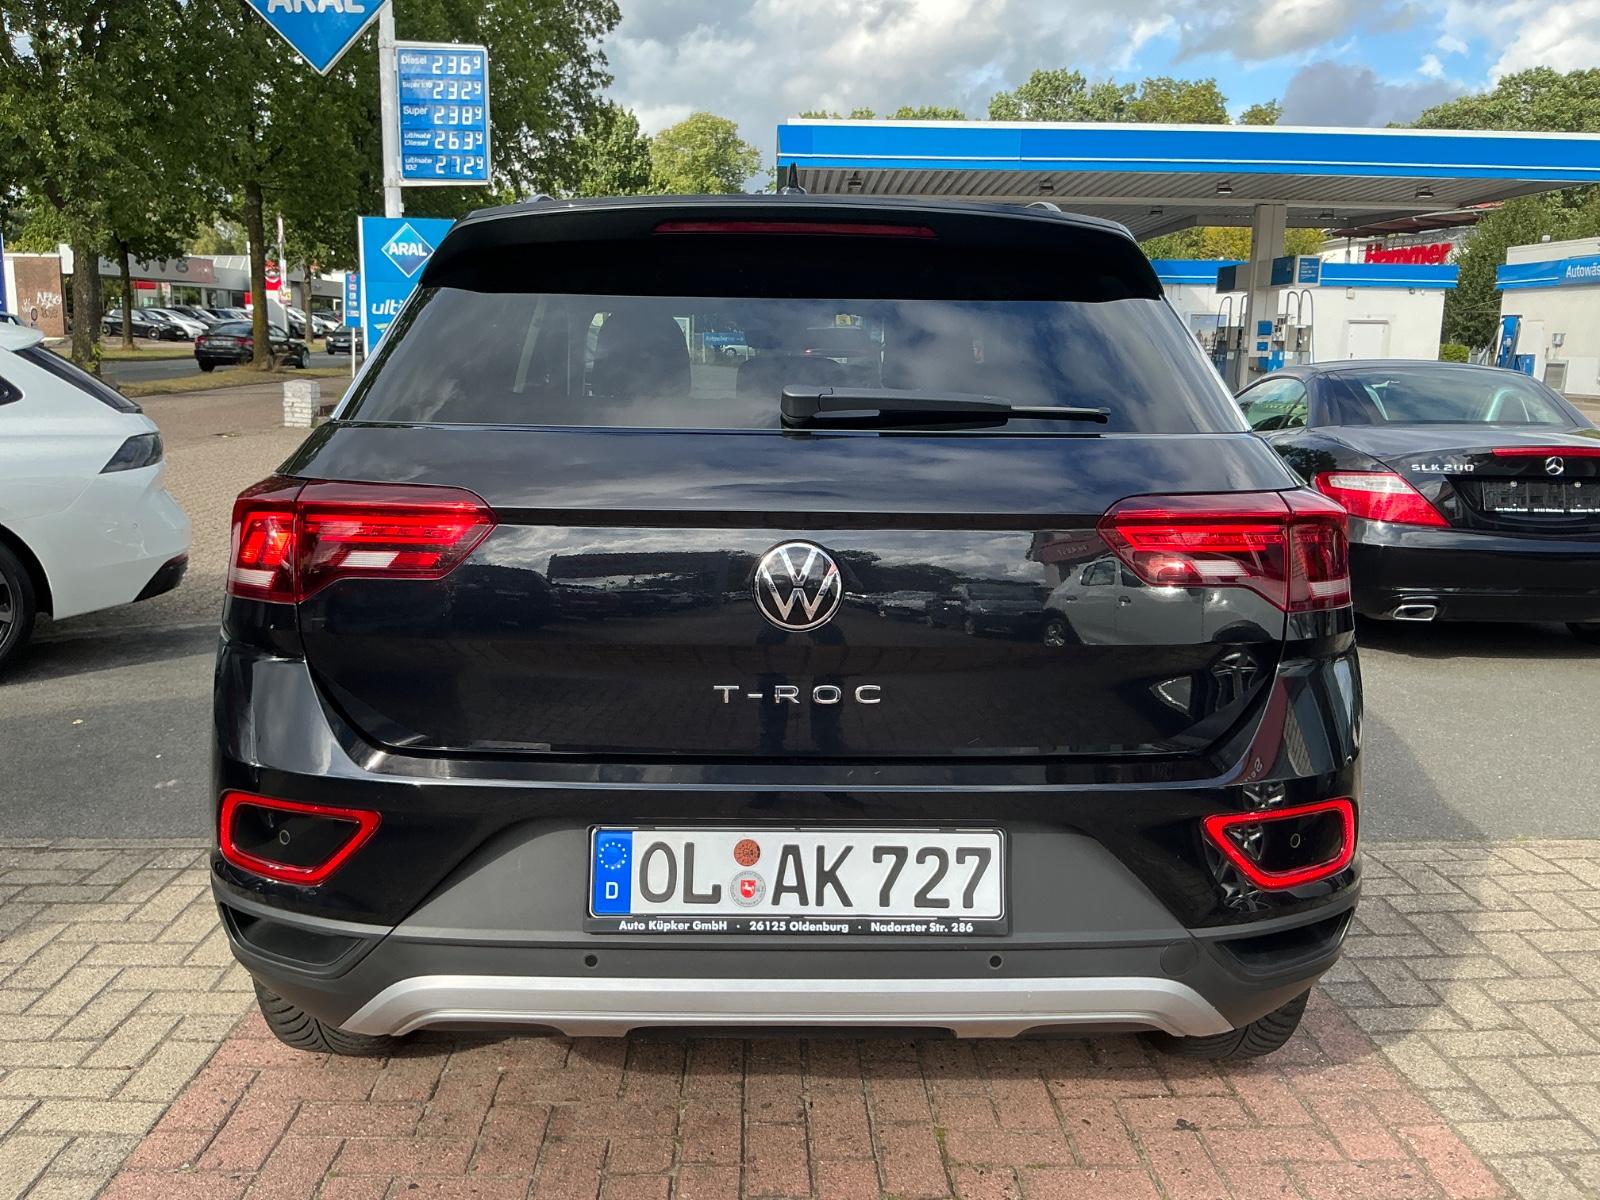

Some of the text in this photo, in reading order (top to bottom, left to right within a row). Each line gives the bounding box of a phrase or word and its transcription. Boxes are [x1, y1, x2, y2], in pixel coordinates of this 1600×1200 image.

[401, 55, 427, 65] Diesel
[403, 106, 428, 117] Super
[388, 242, 428, 257] ARAL
[1411, 463, 1441, 471] SLK
[713, 684, 881, 704] T-ROC
[638, 840, 722, 905] OL
[770, 844, 854, 907] AK
[872, 845, 992, 909] 727
[605, 881, 619, 900] D
[618, 919, 973, 934] Auto Küpker GmbH 26125 Oldenburg Nadorster Str. 286
